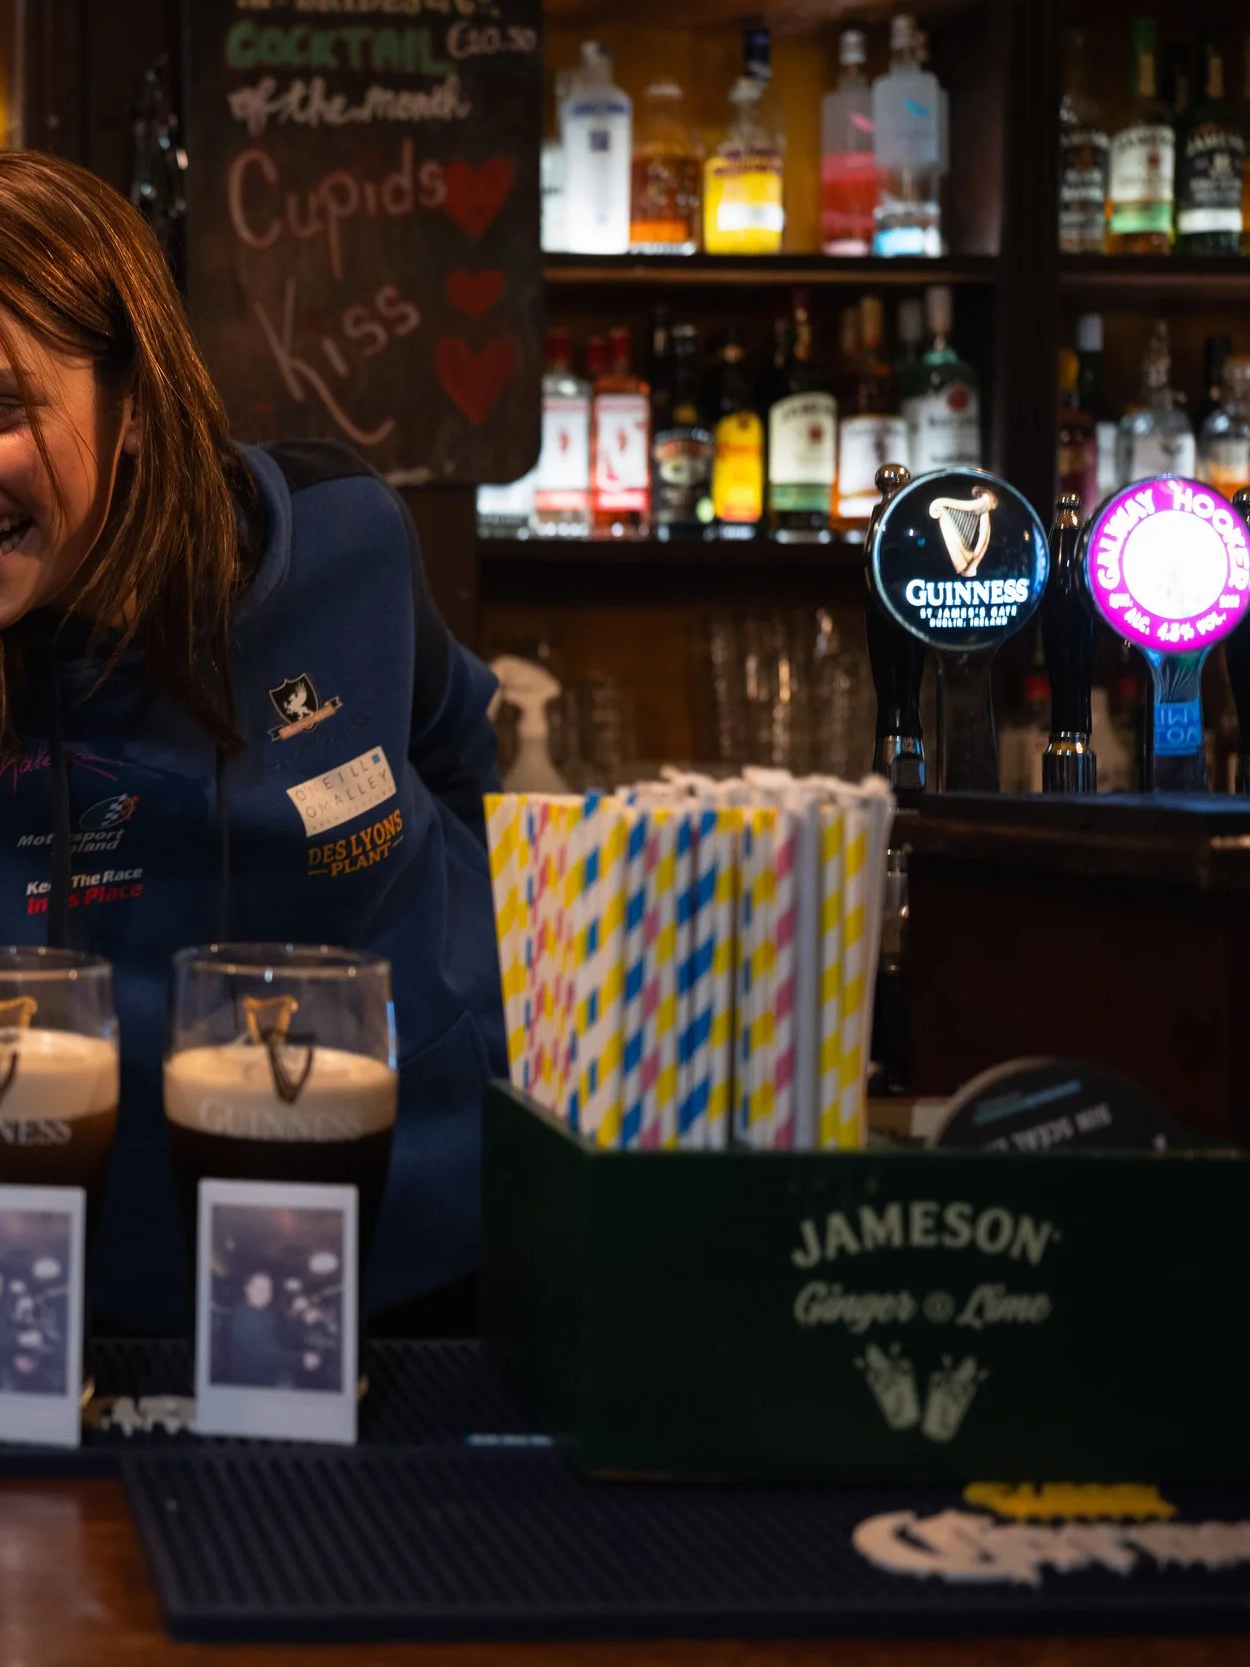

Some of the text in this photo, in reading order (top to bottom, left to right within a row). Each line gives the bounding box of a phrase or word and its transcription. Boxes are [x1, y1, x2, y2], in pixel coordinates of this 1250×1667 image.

[227, 22, 452, 75] COCKTAIL
[227, 137, 448, 280] Cupids
[253, 278, 421, 446] Kiss
[1097, 488, 1157, 590] GALWAY
[906, 578, 1029, 607] GUINNESS
[17, 828, 126, 848] Motsport
[308, 840, 347, 866] DES
[350, 808, 403, 856] LYONS
[330, 841, 393, 878] PLANT
[71, 873, 100, 889] The
[102, 868, 144, 883] Race
[83, 883, 143, 906] Place
[791, 1201, 1053, 1268] JAMESON
[794, 1280, 917, 1334] Ginger
[955, 1283, 1053, 1330] Lime
